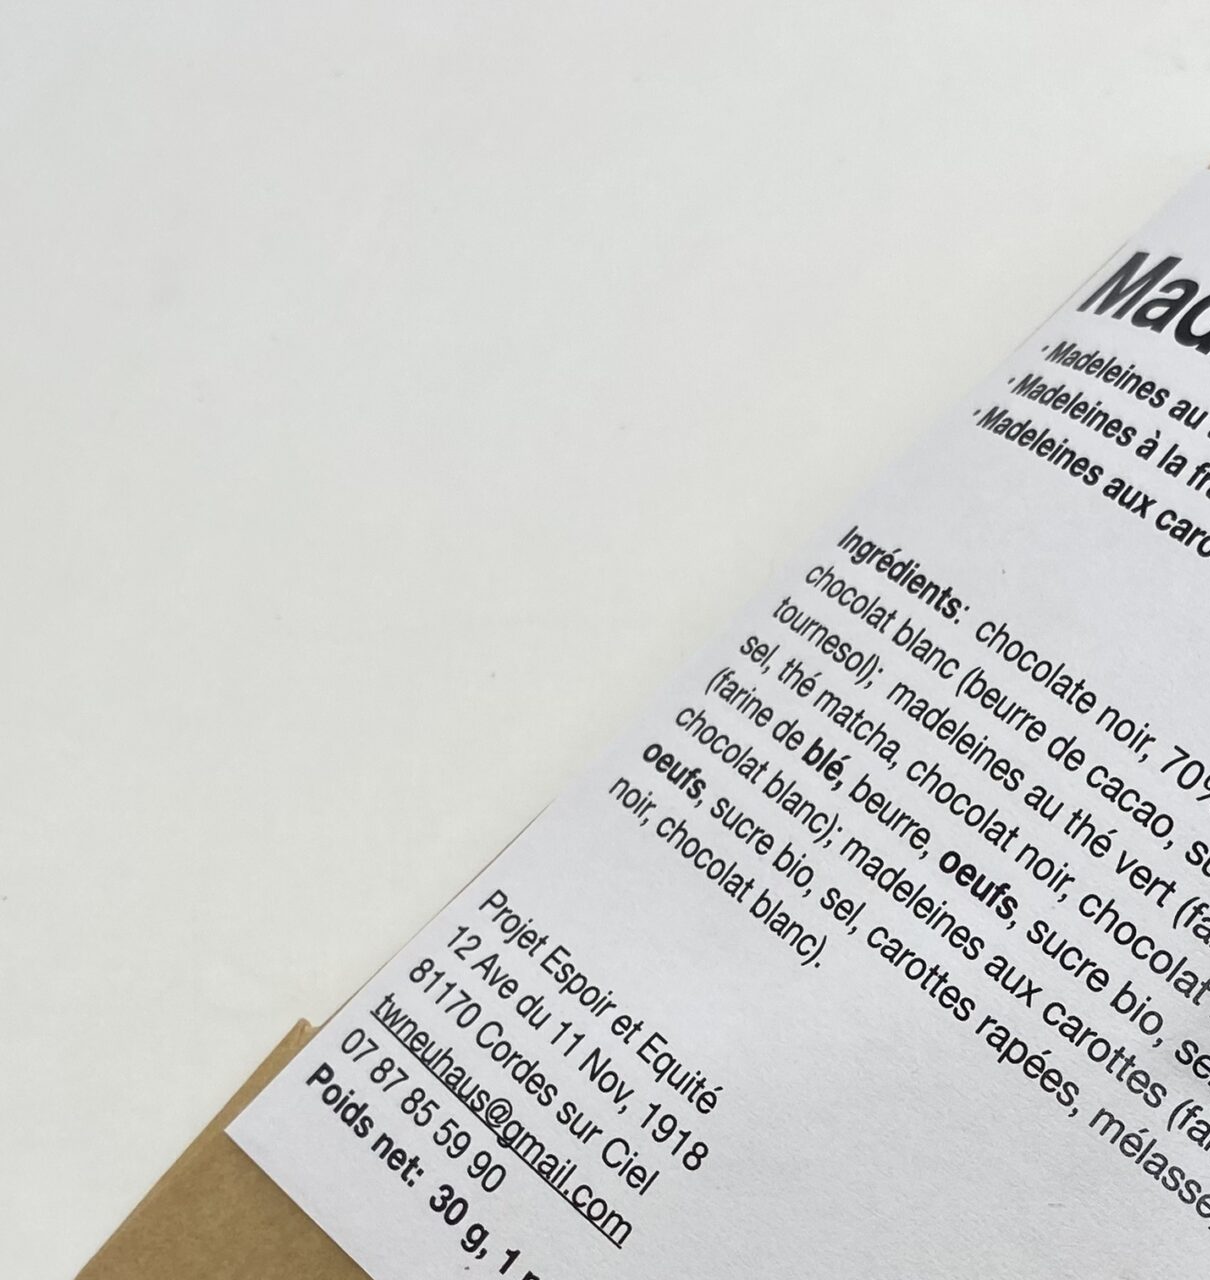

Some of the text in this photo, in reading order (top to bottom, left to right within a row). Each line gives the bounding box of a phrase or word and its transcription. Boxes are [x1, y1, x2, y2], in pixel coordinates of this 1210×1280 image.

[975, 406, 1104, 486] Madeleines
[1102, 478, 1157, 519] aux
[1010, 373, 1137, 446] Madeleines
[1135, 430, 1161, 460] à
[1157, 443, 1188, 477] la
[1044, 341, 1170, 408] Madeleines
[1168, 400, 1208, 430] au
[773, 596, 883, 689] tournesol);
[886, 682, 1024, 791] madeleines
[1024, 785, 1064, 822] au
[1064, 809, 1118, 858] thé
[1116, 850, 1176, 908] vert
[806, 566, 897, 634] chocolat
[892, 618, 960, 679] blanc
[955, 667, 1046, 742] (beurre
[1048, 736, 1085, 771] de
[1086, 766, 1174, 850] cacao,
[837, 525, 970, 624] Ingrédients:
[976, 621, 1096, 714] chocolate
[1096, 706, 1156, 763] noir,
[609, 777, 827, 968] noir, chocolat blanc).
[705, 667, 773, 727] (farine
[772, 719, 804, 751] de
[801, 737, 851, 791] blé,
[848, 773, 930, 860] beurre,
[939, 851, 1018, 930] oeufs,
[1027, 920, 1109, 992] sucre
[1110, 980, 1163, 1048] bio,
[740, 636, 780, 674] sel,
[778, 658, 822, 697] thé
[813, 690, 900, 770] matcha,
[906, 760, 1020, 853] chocolat
[1015, 843, 1075, 903] noir,
[479, 889, 723, 1114] Projet Espoir et Equité
[643, 744, 706, 808] oeufs,
[710, 797, 774, 855] sucre
[772, 842, 814, 898] bio,
[820, 888, 866, 935] sel,
[867, 927, 975, 1021] carottes
[975, 1015, 1079, 1117] rapées,
[676, 708, 769, 784] chocolat
[762, 770, 843, 848] blanc);
[840, 837, 984, 960] madeleines
[984, 955, 1043, 1008] aux
[1043, 1002, 1167, 1108] carottes
[341, 1028, 506, 1192] 07 87 85 59 90
[370, 993, 632, 1249] twneuhaus@gmail.com
[409, 958, 660, 1196] 81170 Cordes sur Ciel
[448, 926, 708, 1171] 12 Ave du 11 Nov, 1918
[306, 1062, 374, 1138] Poids
[371, 1133, 424, 1187] net:
[429, 1184, 468, 1225] 30
[461, 1223, 489, 1259] g,
[499, 1249, 520, 1275] 1
